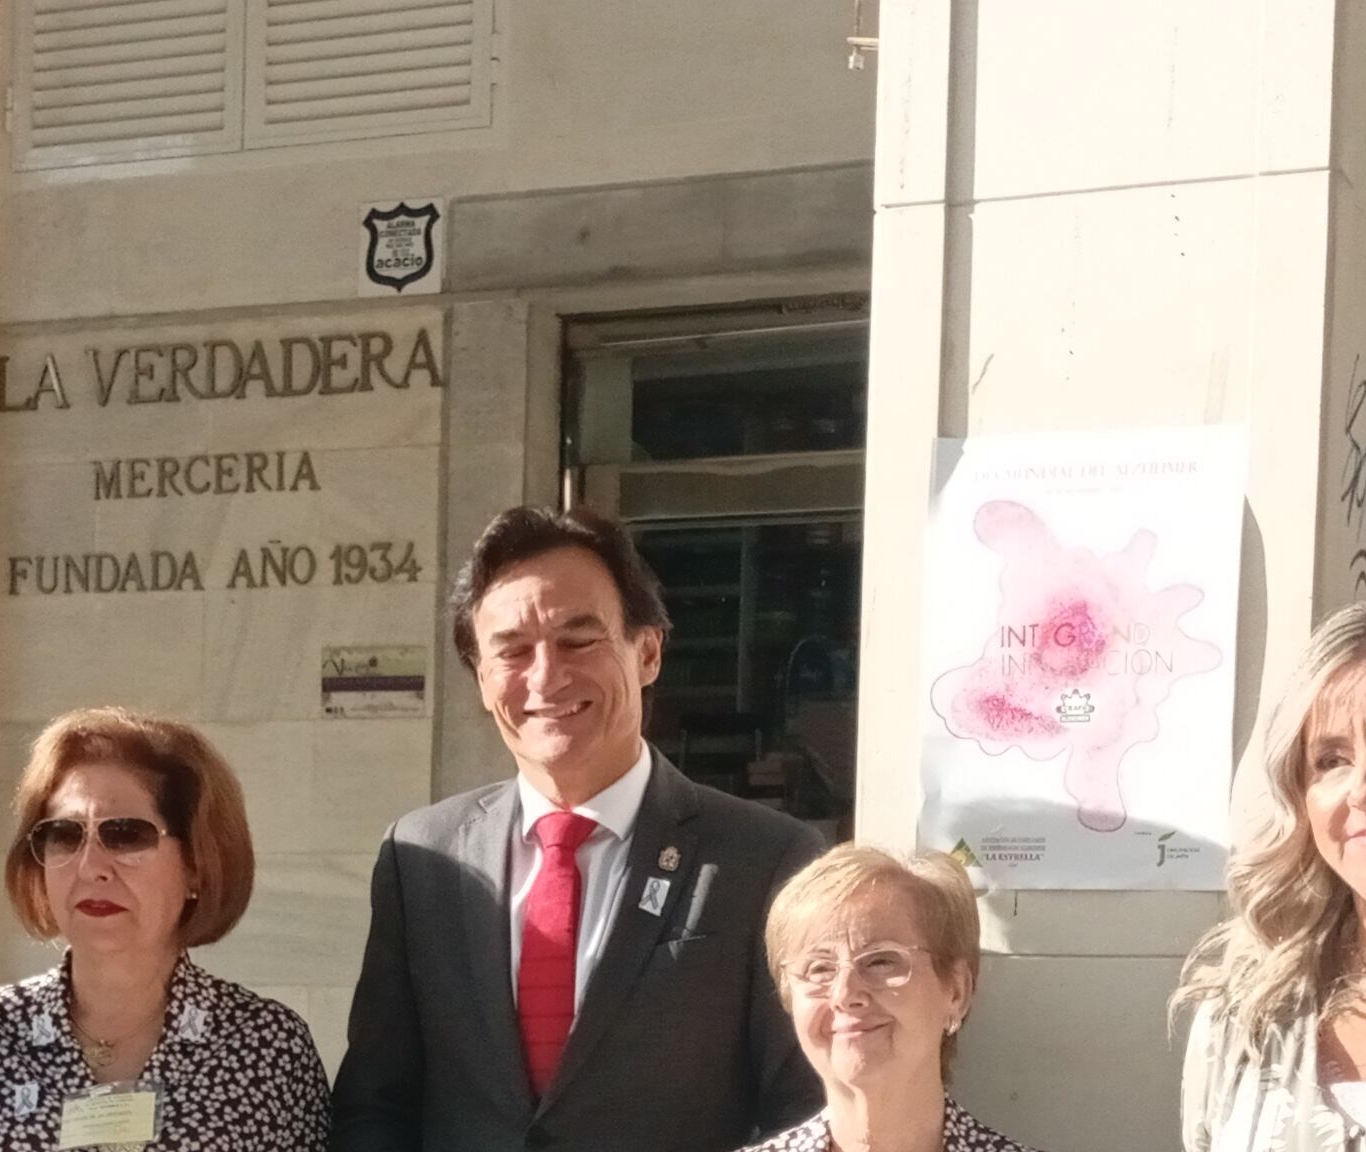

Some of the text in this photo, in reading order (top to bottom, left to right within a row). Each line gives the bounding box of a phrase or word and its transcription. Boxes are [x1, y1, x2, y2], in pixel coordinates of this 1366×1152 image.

[376, 254, 423, 269] acacio
[85, 328, 447, 408] VERDADERA
[93, 451, 321, 501] MERCERIA
[8, 539, 423, 595] FUNDADA AÑO 1934
